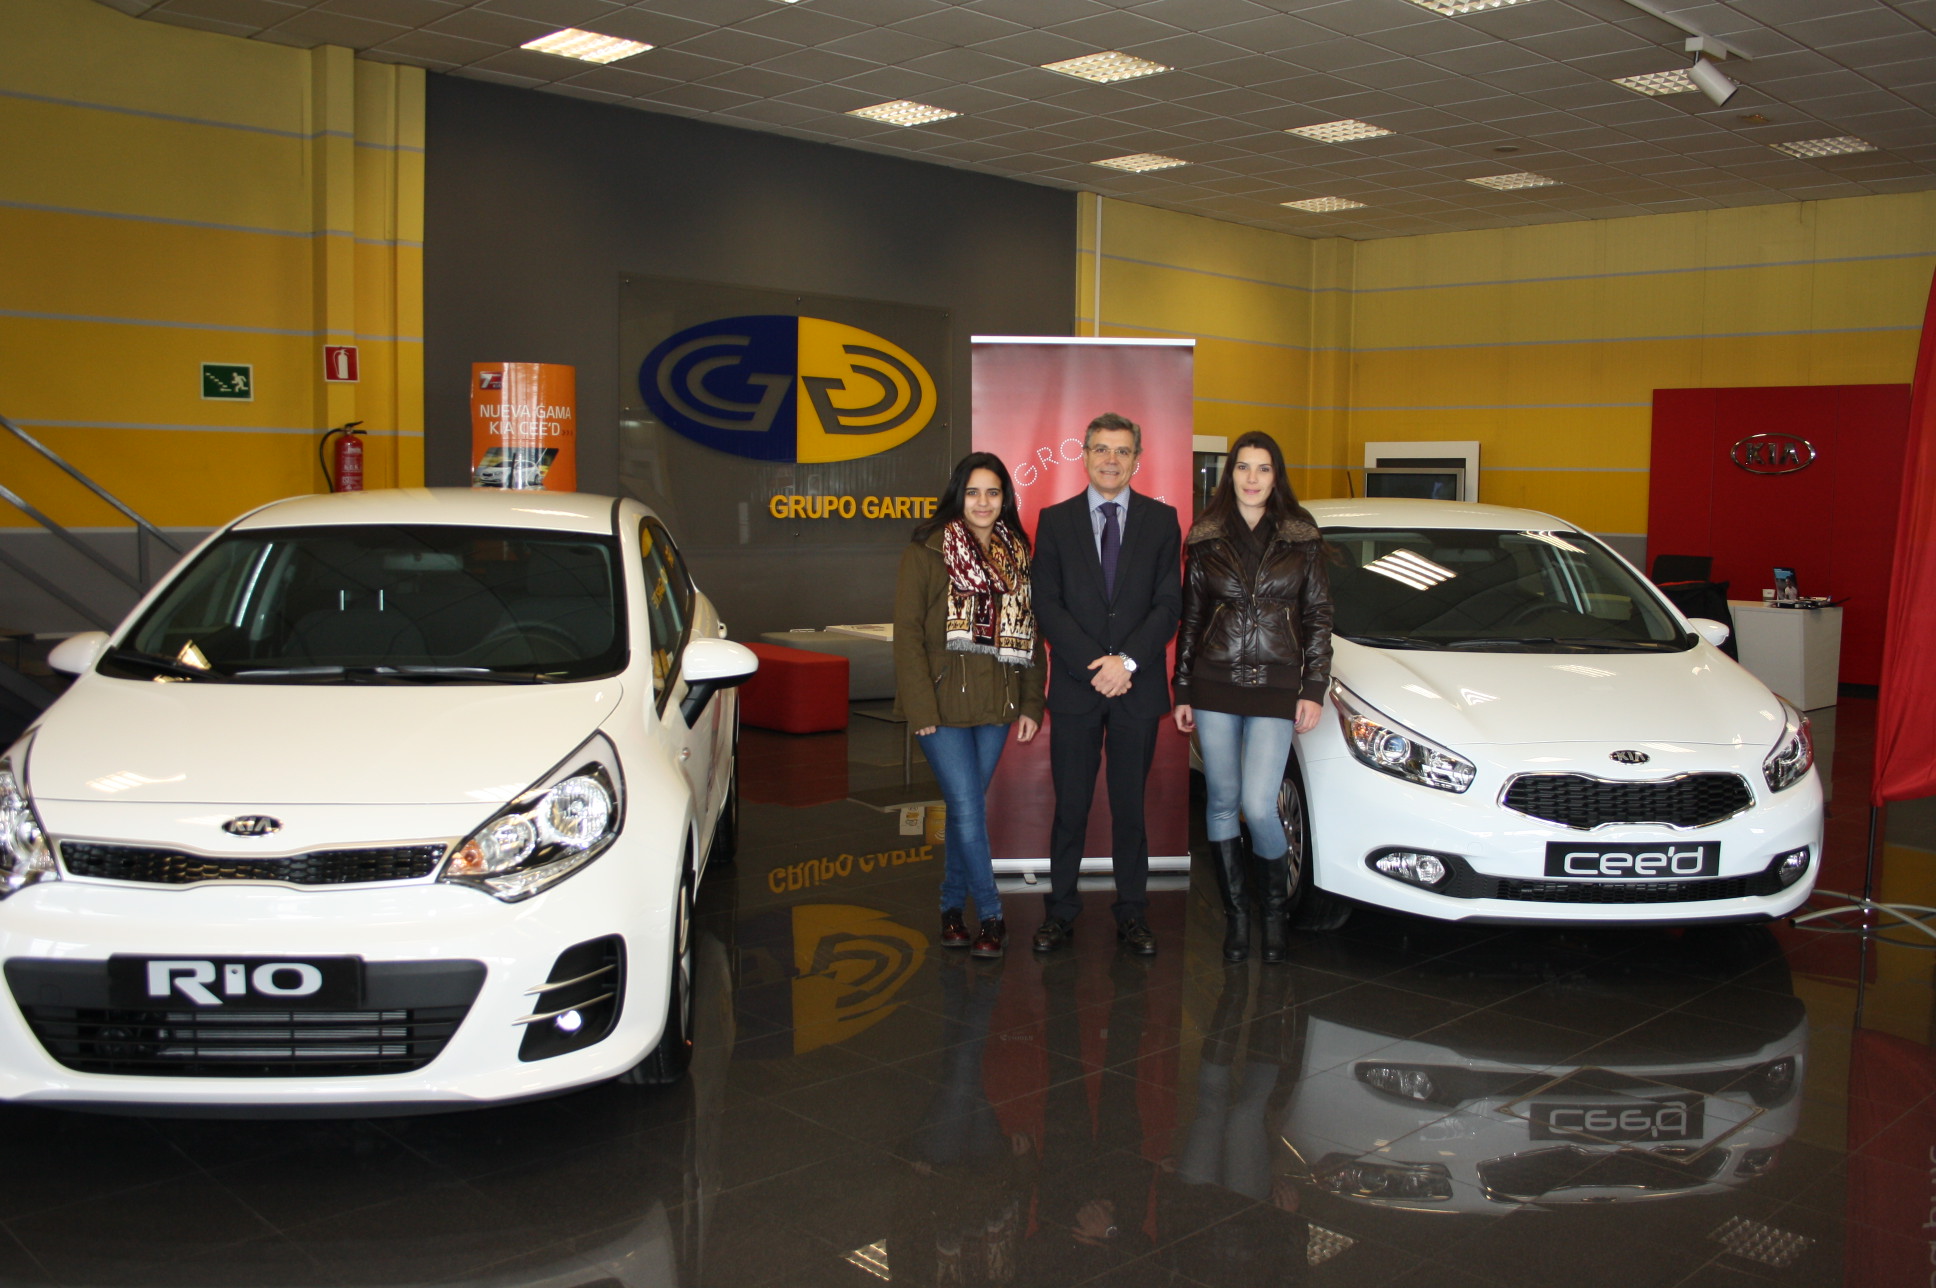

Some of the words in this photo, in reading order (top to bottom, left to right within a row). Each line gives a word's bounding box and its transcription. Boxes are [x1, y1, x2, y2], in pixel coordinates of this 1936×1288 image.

[480, 404, 531, 418] NUEVA
[536, 405, 572, 420] GAMA
[489, 421, 514, 435] KIA
[520, 421, 560, 436] CEE'D
[1745, 442, 1799, 465] KIA
[769, 494, 857, 519] GRUPO
[862, 496, 938, 519] GARTE
